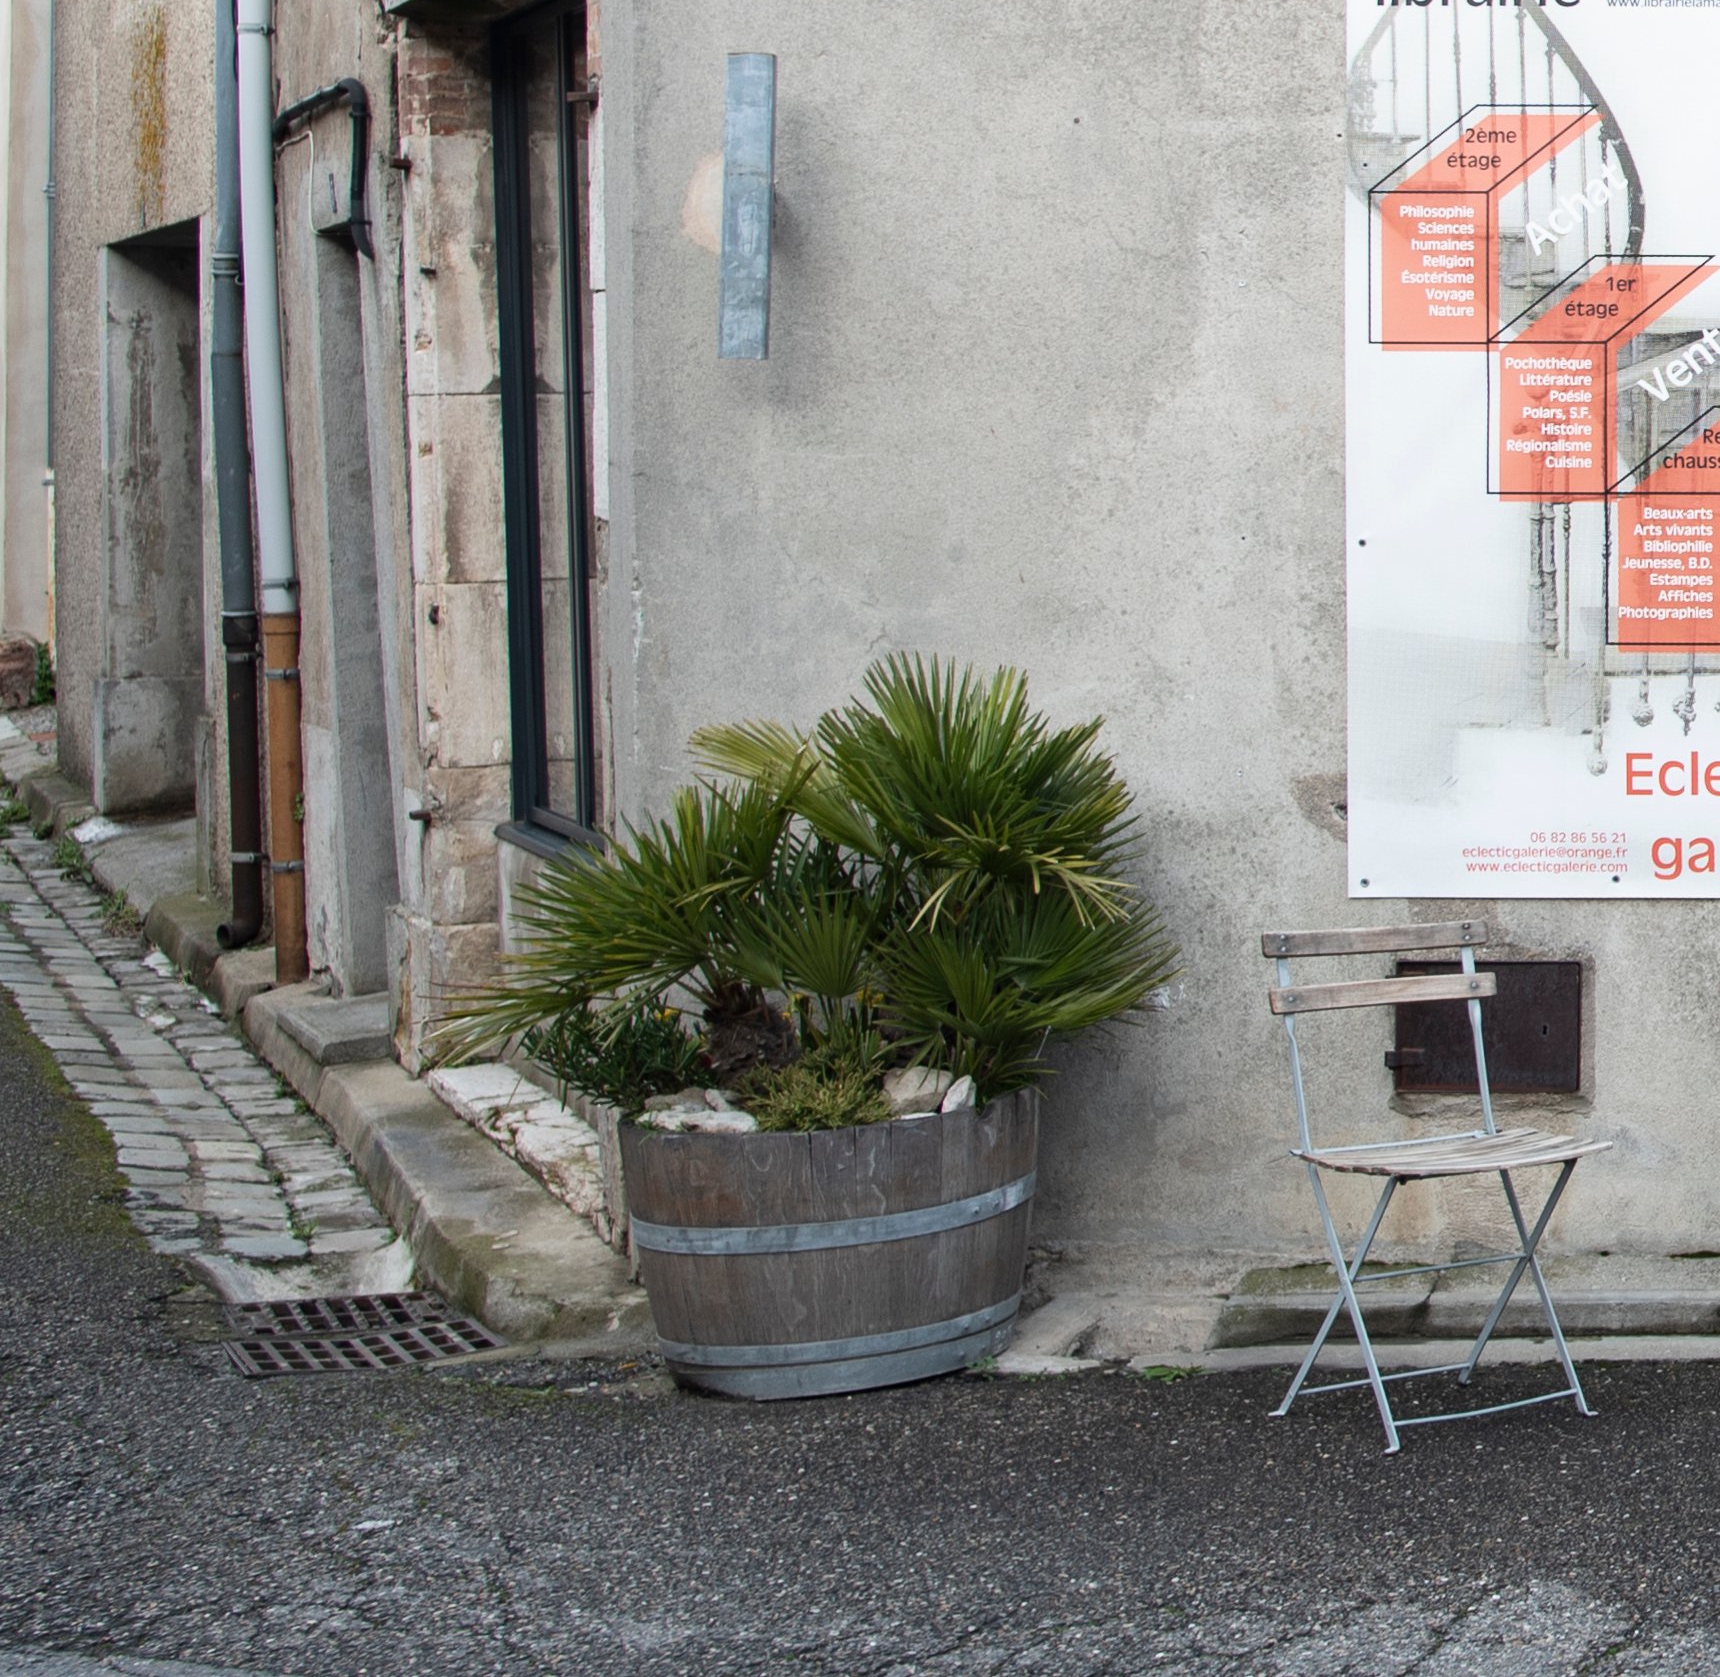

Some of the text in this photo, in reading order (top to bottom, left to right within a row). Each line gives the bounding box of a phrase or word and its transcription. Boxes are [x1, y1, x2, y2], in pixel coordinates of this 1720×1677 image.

[1465, 128, 1517, 144] 2ème
[1447, 152, 1502, 171] étage
[1400, 205, 1475, 220] Philosophie
[1525, 162, 1629, 257] Achat
[1417, 222, 1475, 235] Sciences
[1411, 239, 1475, 252] humaines
[1423, 255, 1475, 270] Religion
[1401, 269, 1475, 285] Ésotérisme
[1605, 276, 1636, 292] 1er
[1425, 288, 1475, 303] Voyage
[1428, 304, 1475, 318] Nature
[1565, 300, 1619, 319] étage
[1505, 357, 1593, 372] Pochothèque
[1519, 373, 1593, 387] Littérature
[1549, 389, 1593, 403] Poésie
[1522, 406, 1593, 421] Polars, S.F.
[1541, 422, 1593, 436] Histoire
[1506, 439, 1593, 454] Régionalisme
[1545, 456, 1593, 469] Cuisine
[1644, 507, 1714, 521] Beaux-arts
[1633, 523, 1714, 537] Arts vivants
[1644, 540, 1714, 554] Bibliophilie
[1622, 557, 1713, 571] Jeunesse, B.D.
[1650, 573, 1714, 588] Estampes
[1658, 590, 1714, 603] Affiches
[1618, 606, 1714, 622] Photographies
[1530, 832, 1627, 844] 06 82 86 56 21
[1462, 846, 1628, 861] eclecticgalerie@orange.fr
[1466, 861, 1628, 874] www.eclecticgalerie.com
